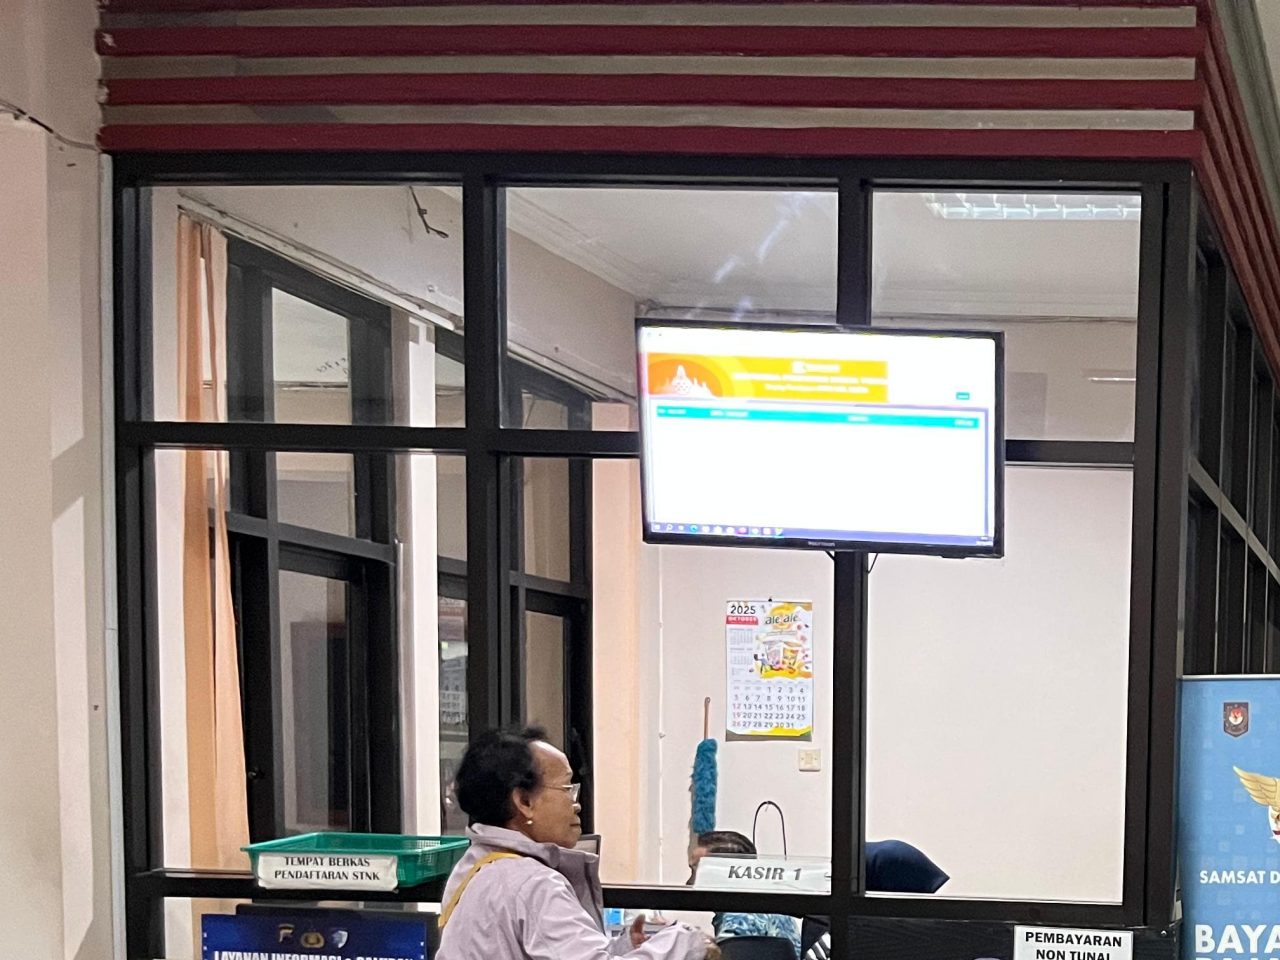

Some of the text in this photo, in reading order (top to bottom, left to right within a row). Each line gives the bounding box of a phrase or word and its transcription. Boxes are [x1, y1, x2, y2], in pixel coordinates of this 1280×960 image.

[730, 605, 756, 614] 2025
[285, 856, 370, 868] TEMPAT BERKAS
[274, 869, 380, 881] PENDAFTARAN STNK
[728, 865, 802, 880] KASIR 1
[1200, 869, 1266, 884] SAMSAT
[1025, 932, 1122, 947] PEMBAYARAN
[1036, 949, 1067, 960] NON
